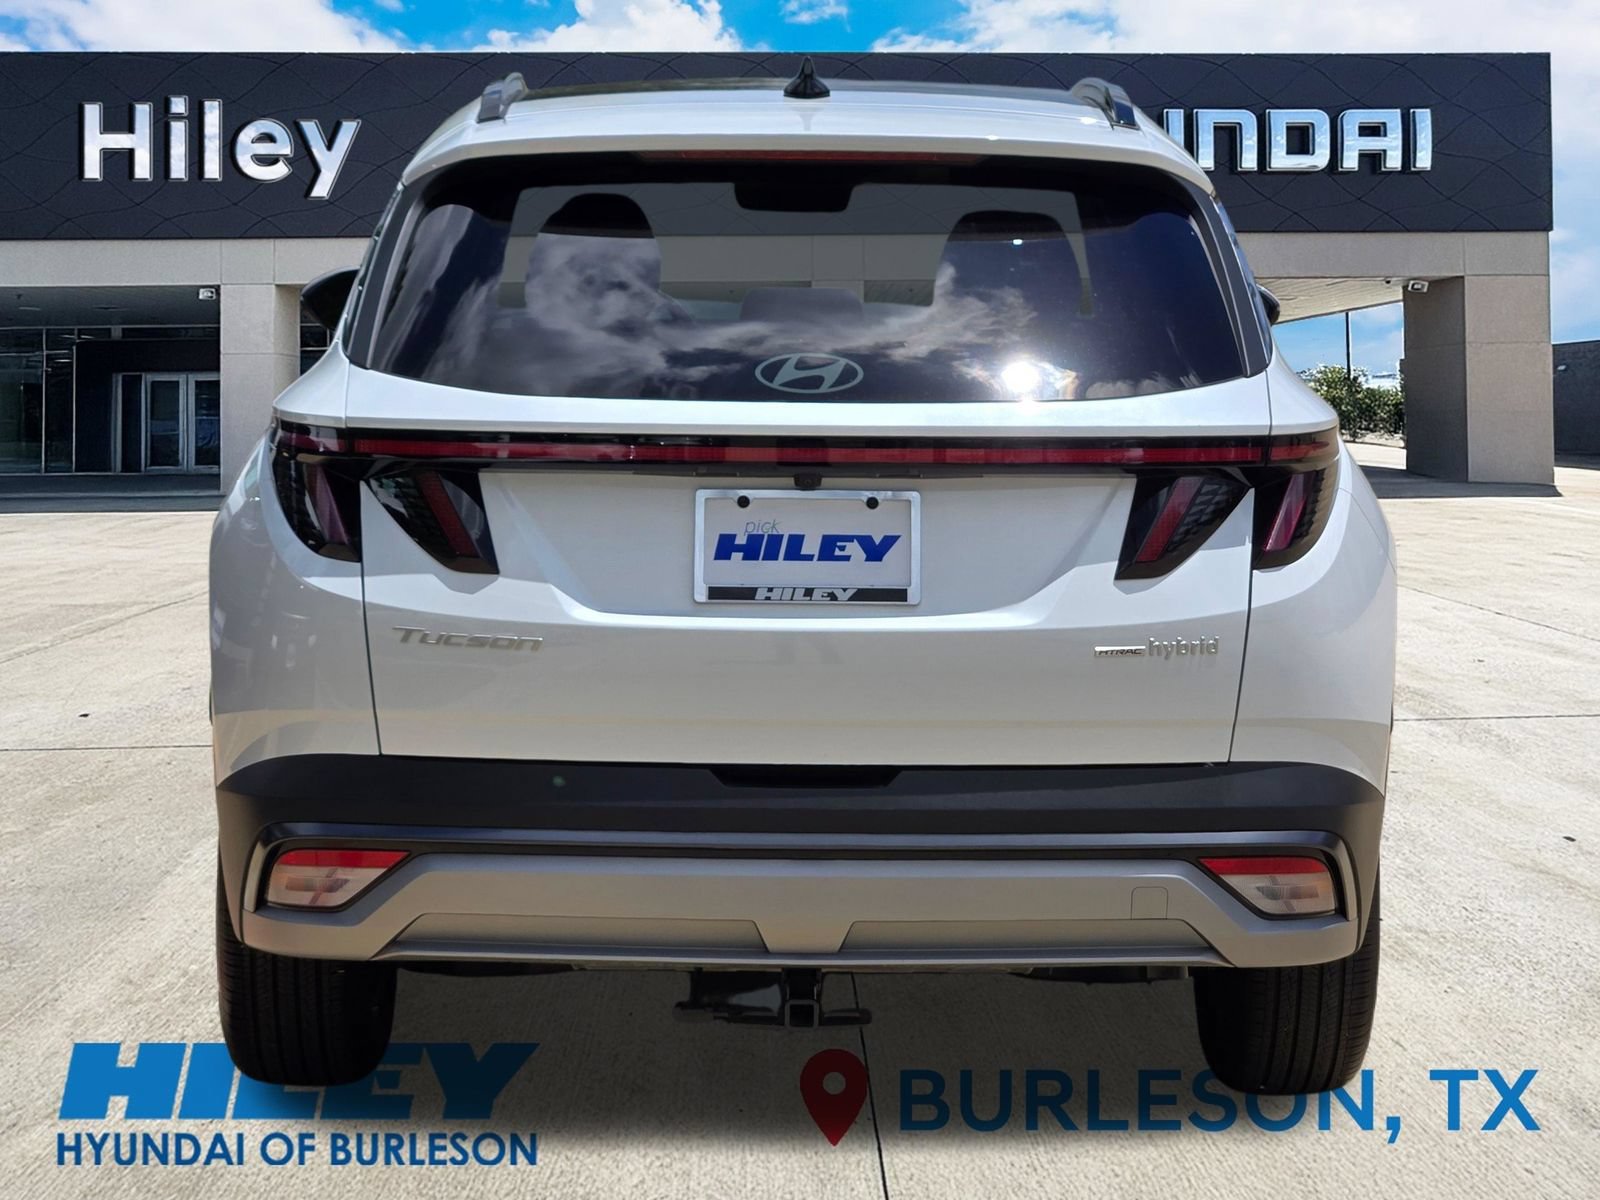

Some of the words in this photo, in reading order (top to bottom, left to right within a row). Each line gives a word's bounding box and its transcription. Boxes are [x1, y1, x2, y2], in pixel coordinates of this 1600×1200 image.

[80, 94, 361, 200] Hiley
[743, 518, 781, 536] pick
[713, 532, 902, 563] HILEY
[754, 587, 858, 601] HILEY
[1148, 635, 1220, 661] hybrid
